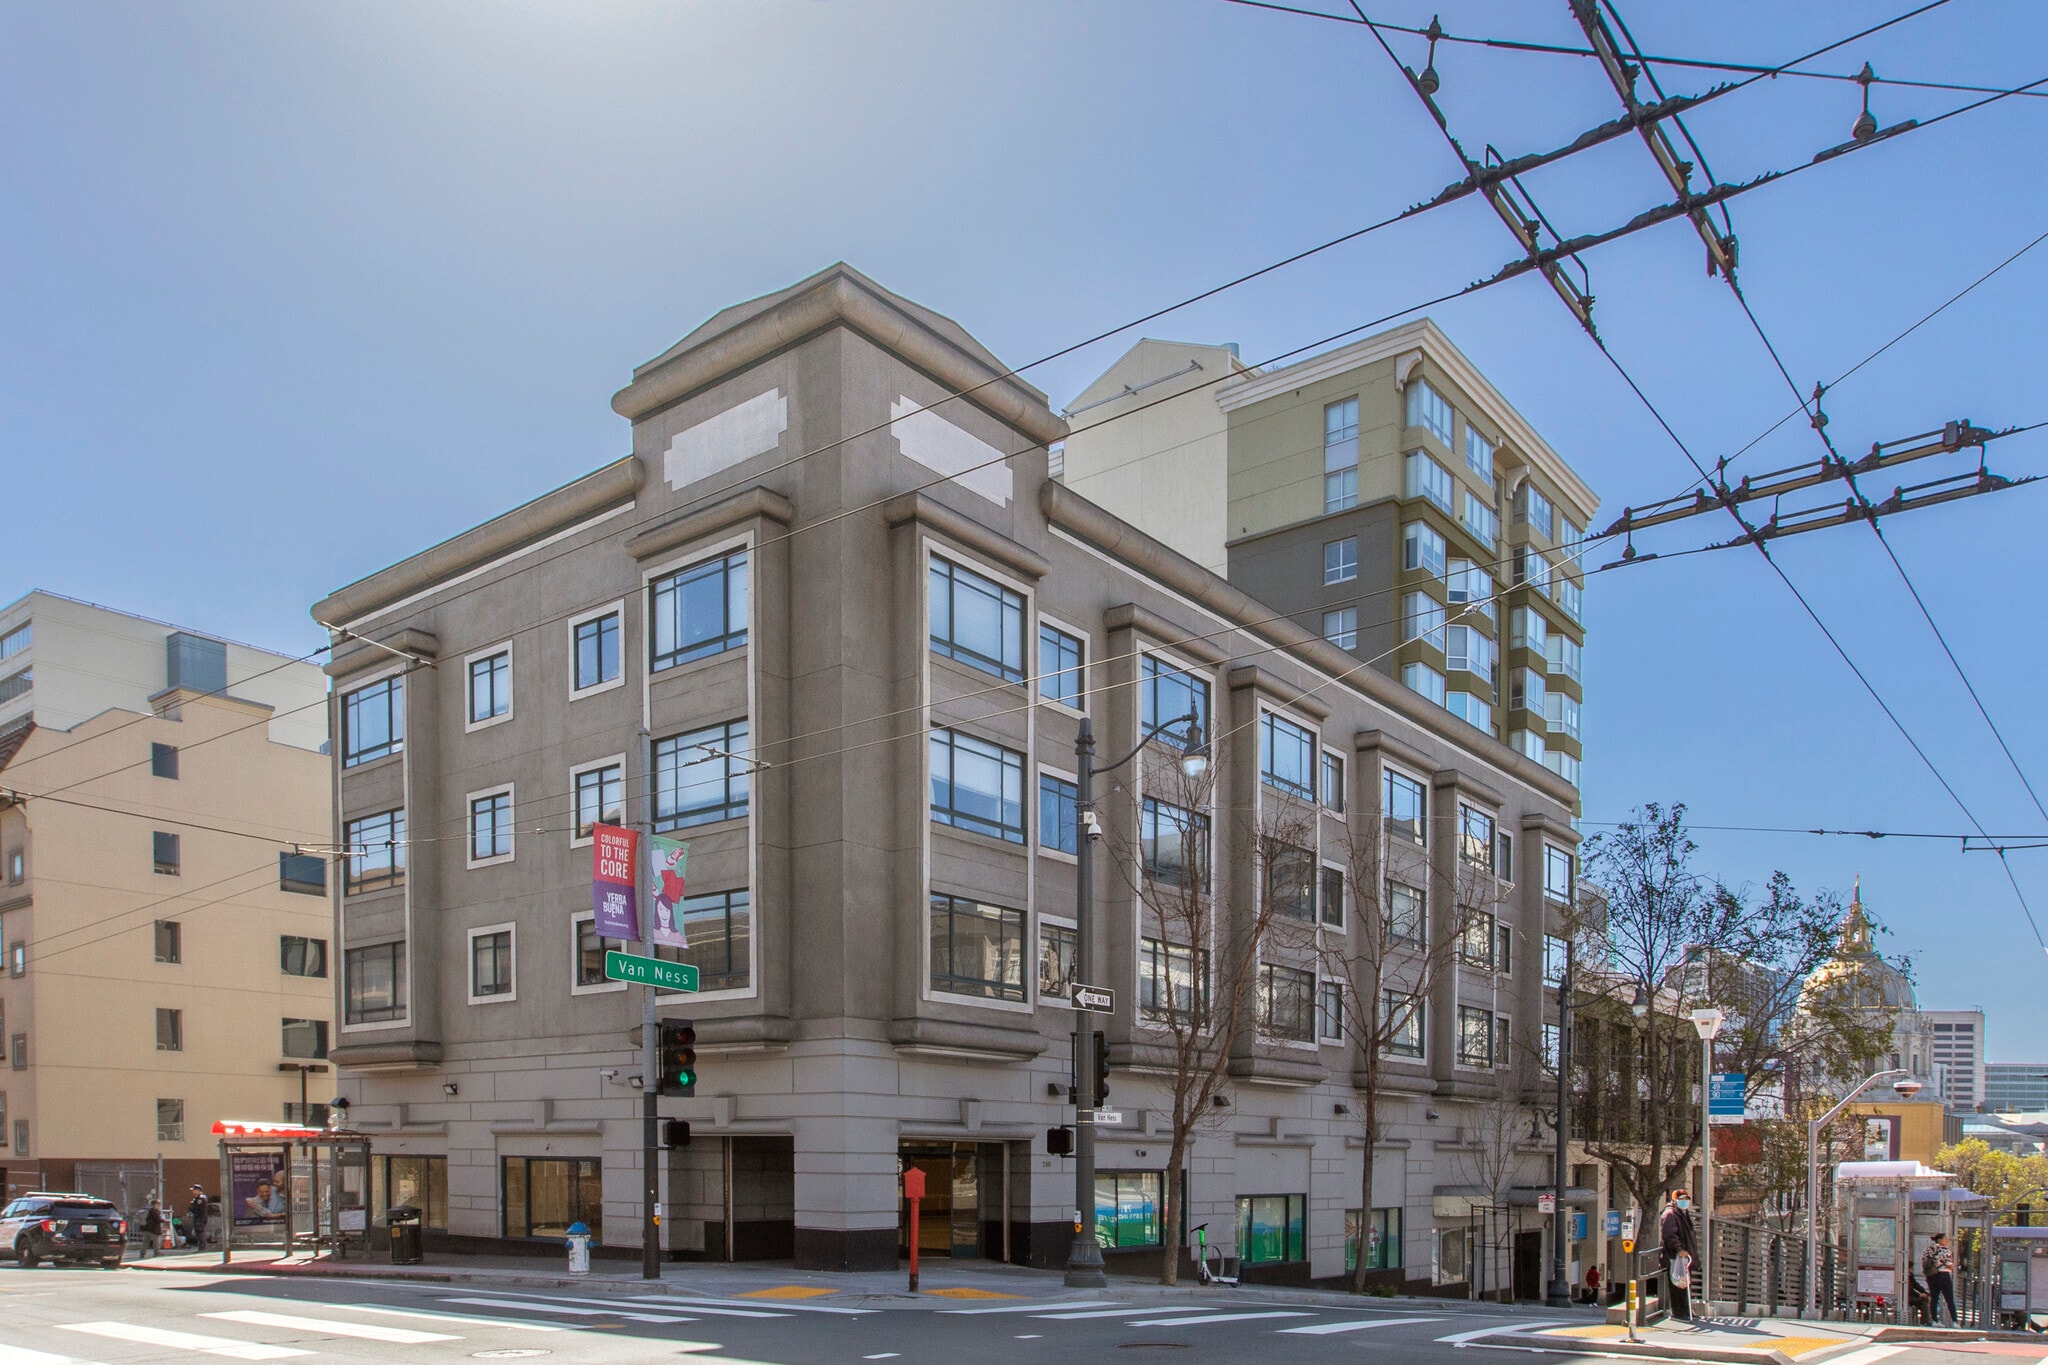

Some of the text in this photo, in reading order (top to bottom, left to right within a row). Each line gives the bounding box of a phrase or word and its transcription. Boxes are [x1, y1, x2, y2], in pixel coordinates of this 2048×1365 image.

[600, 833, 630, 848] COLORFUL
[600, 844, 629, 862] TO THE
[600, 858, 628, 879] CORE
[606, 891, 627, 906] YERBA
[602, 901, 625, 918] BUENA
[618, 959, 689, 985] Van Ness
[1084, 993, 1109, 1005] ONE WAY
